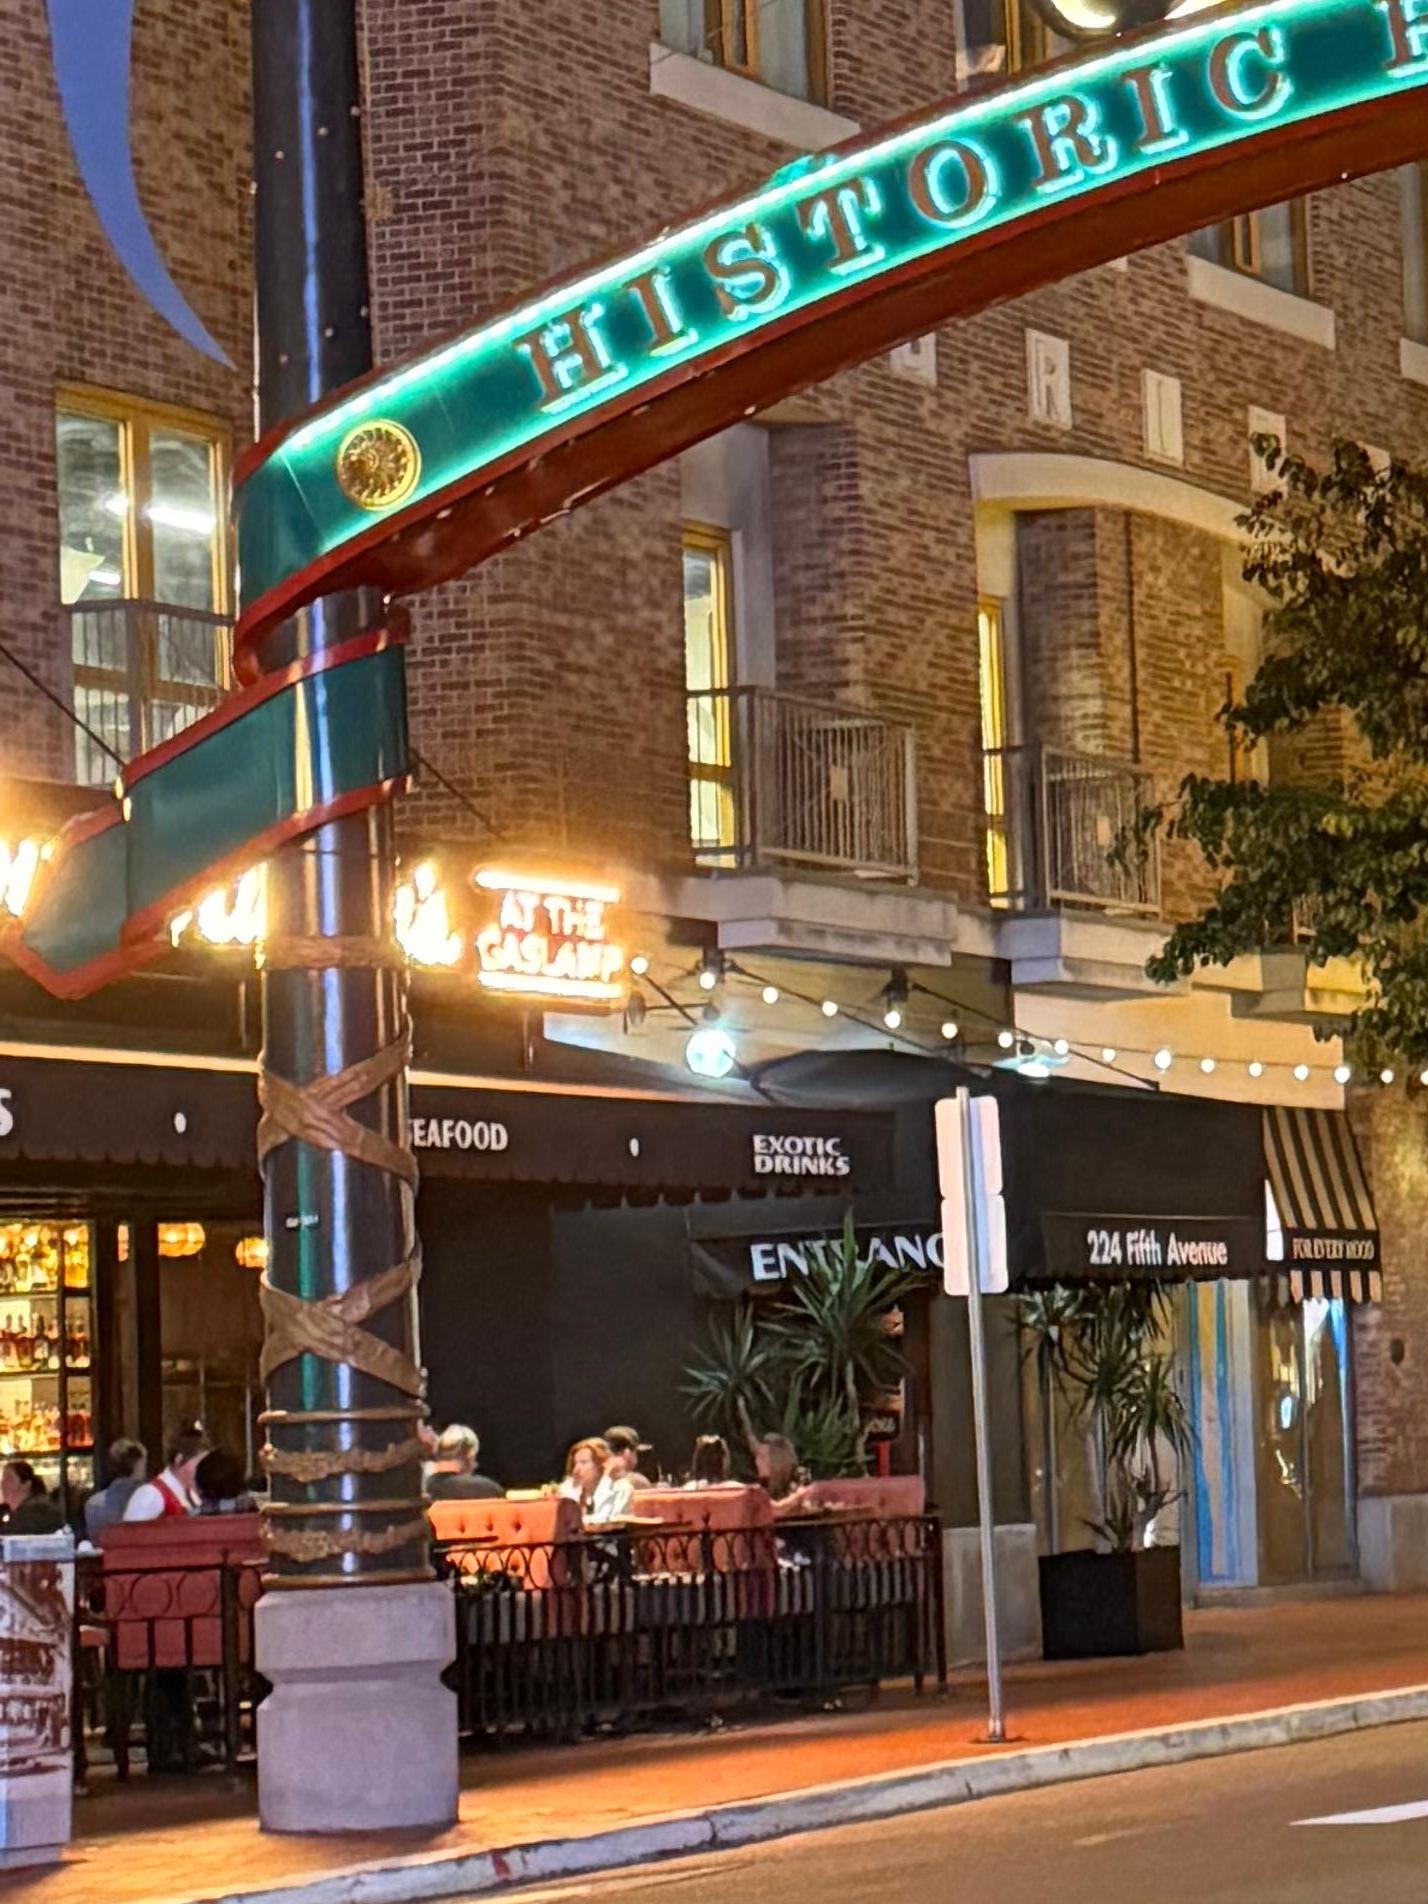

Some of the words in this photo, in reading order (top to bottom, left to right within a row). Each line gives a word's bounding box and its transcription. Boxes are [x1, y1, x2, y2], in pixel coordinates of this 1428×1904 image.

[515, 23, 1294, 417] HISTORIC
[501, 889, 541, 934] AT
[544, 896, 606, 941] THE
[476, 922, 625, 984] GASLAMP
[753, 1134, 841, 1156] EXOTIC
[754, 1154, 850, 1176] DRINKS
[1087, 1229, 1122, 1265] 224
[1125, 1228, 1162, 1266] Fifth
[1166, 1231, 1228, 1266] Avenue
